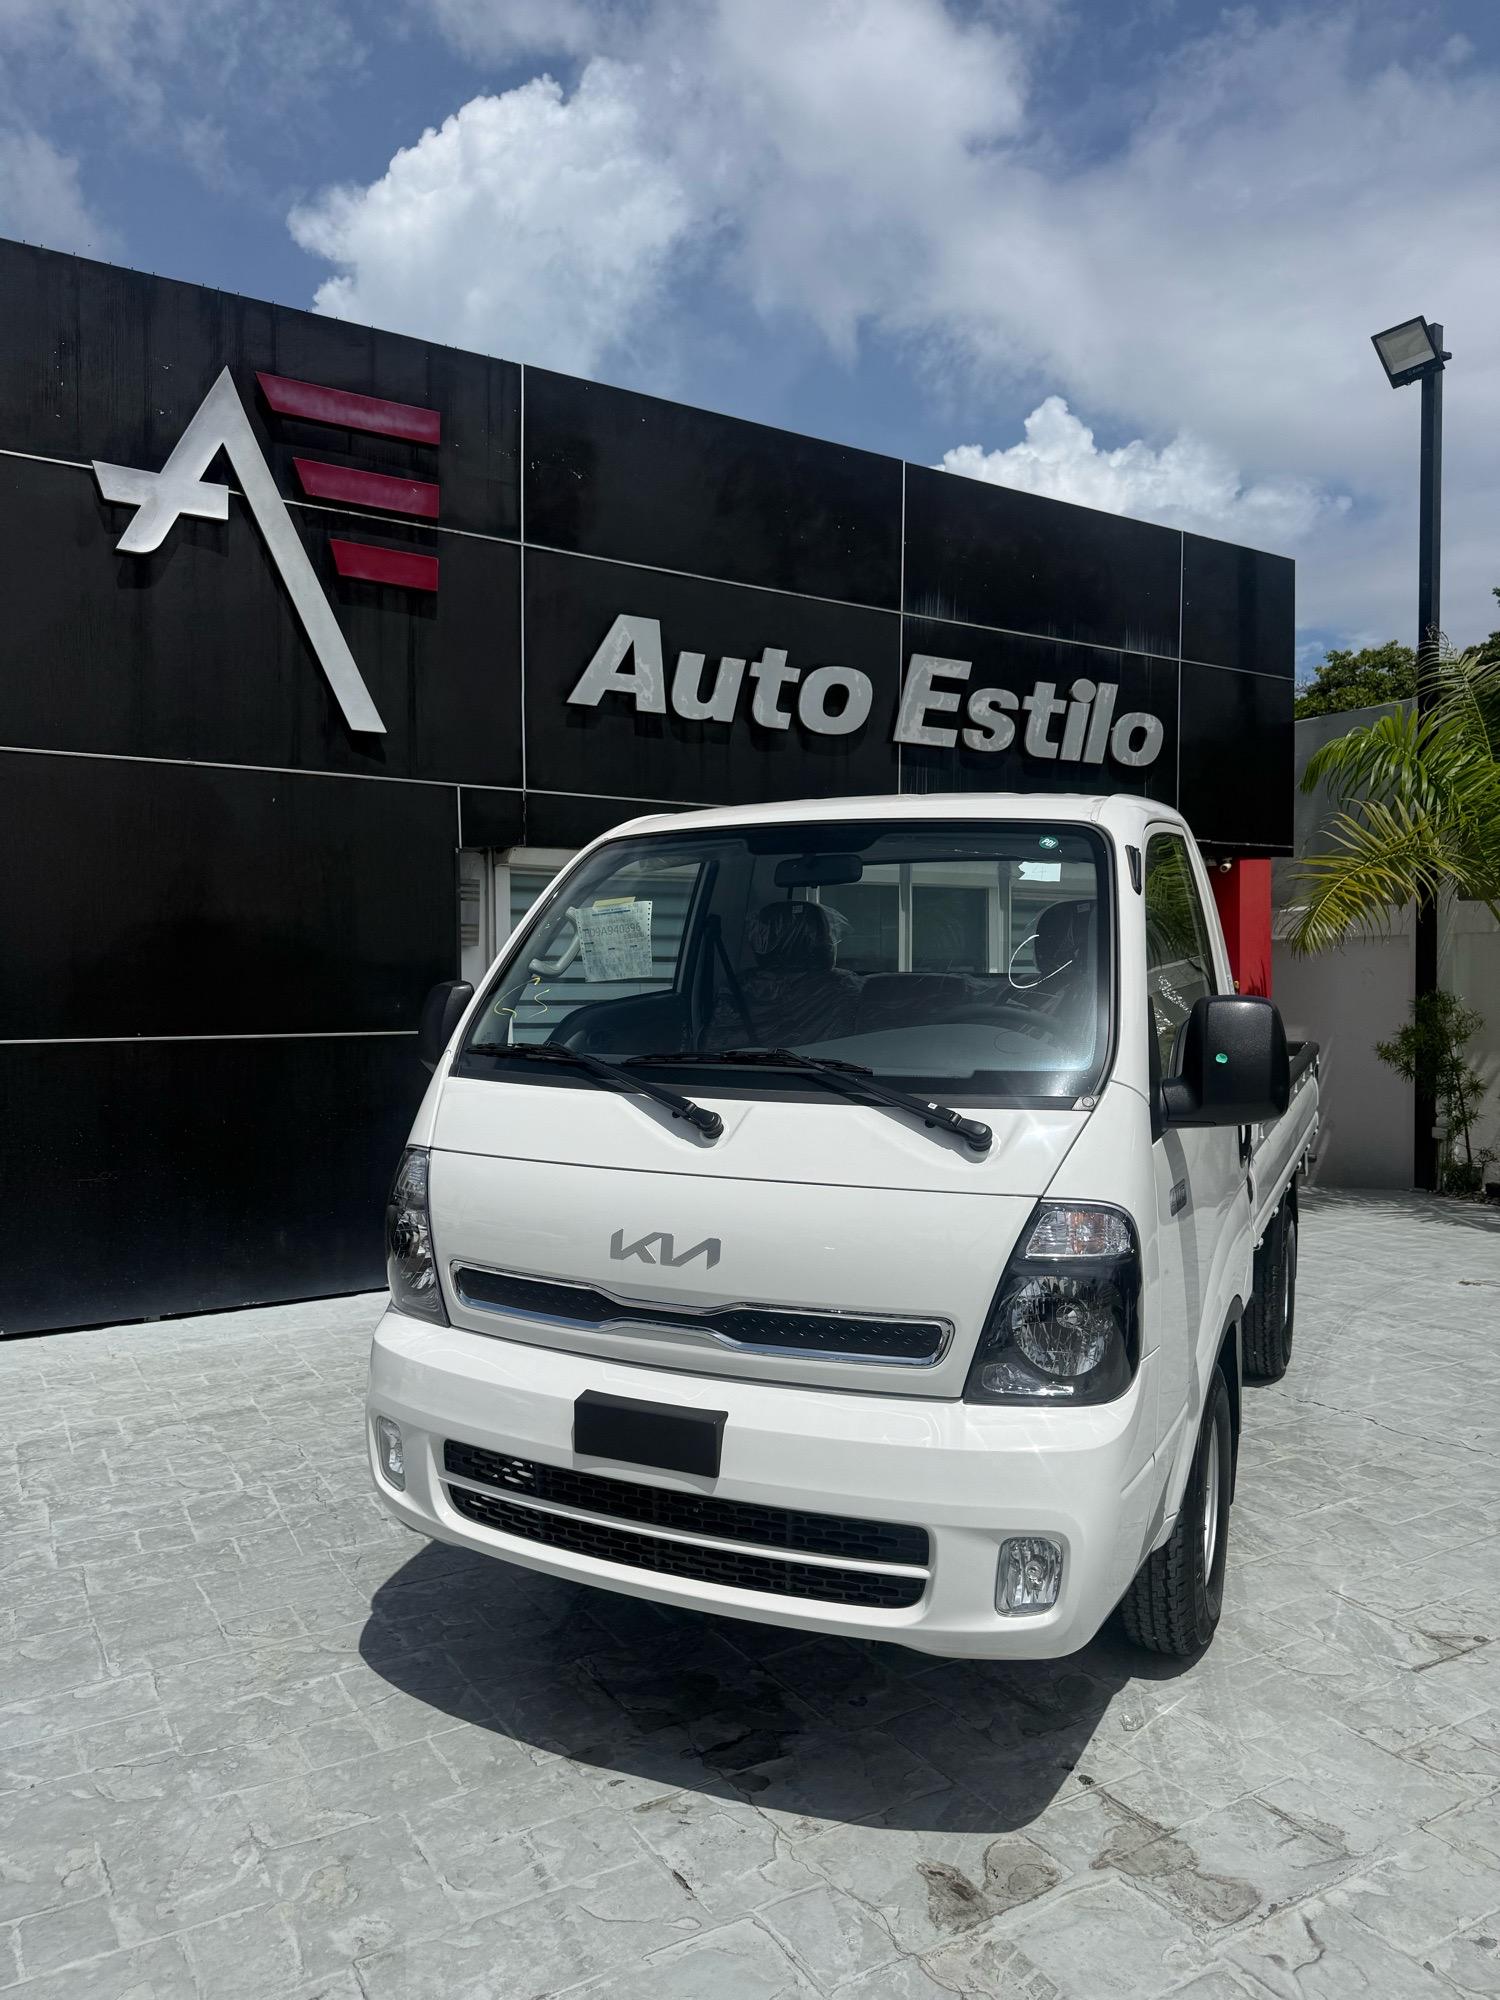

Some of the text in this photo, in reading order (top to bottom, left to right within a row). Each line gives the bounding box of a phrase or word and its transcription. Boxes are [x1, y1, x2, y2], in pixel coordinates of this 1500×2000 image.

[566, 613, 1165, 768] Auto Estilo
[610, 1228, 722, 1270] KIA
